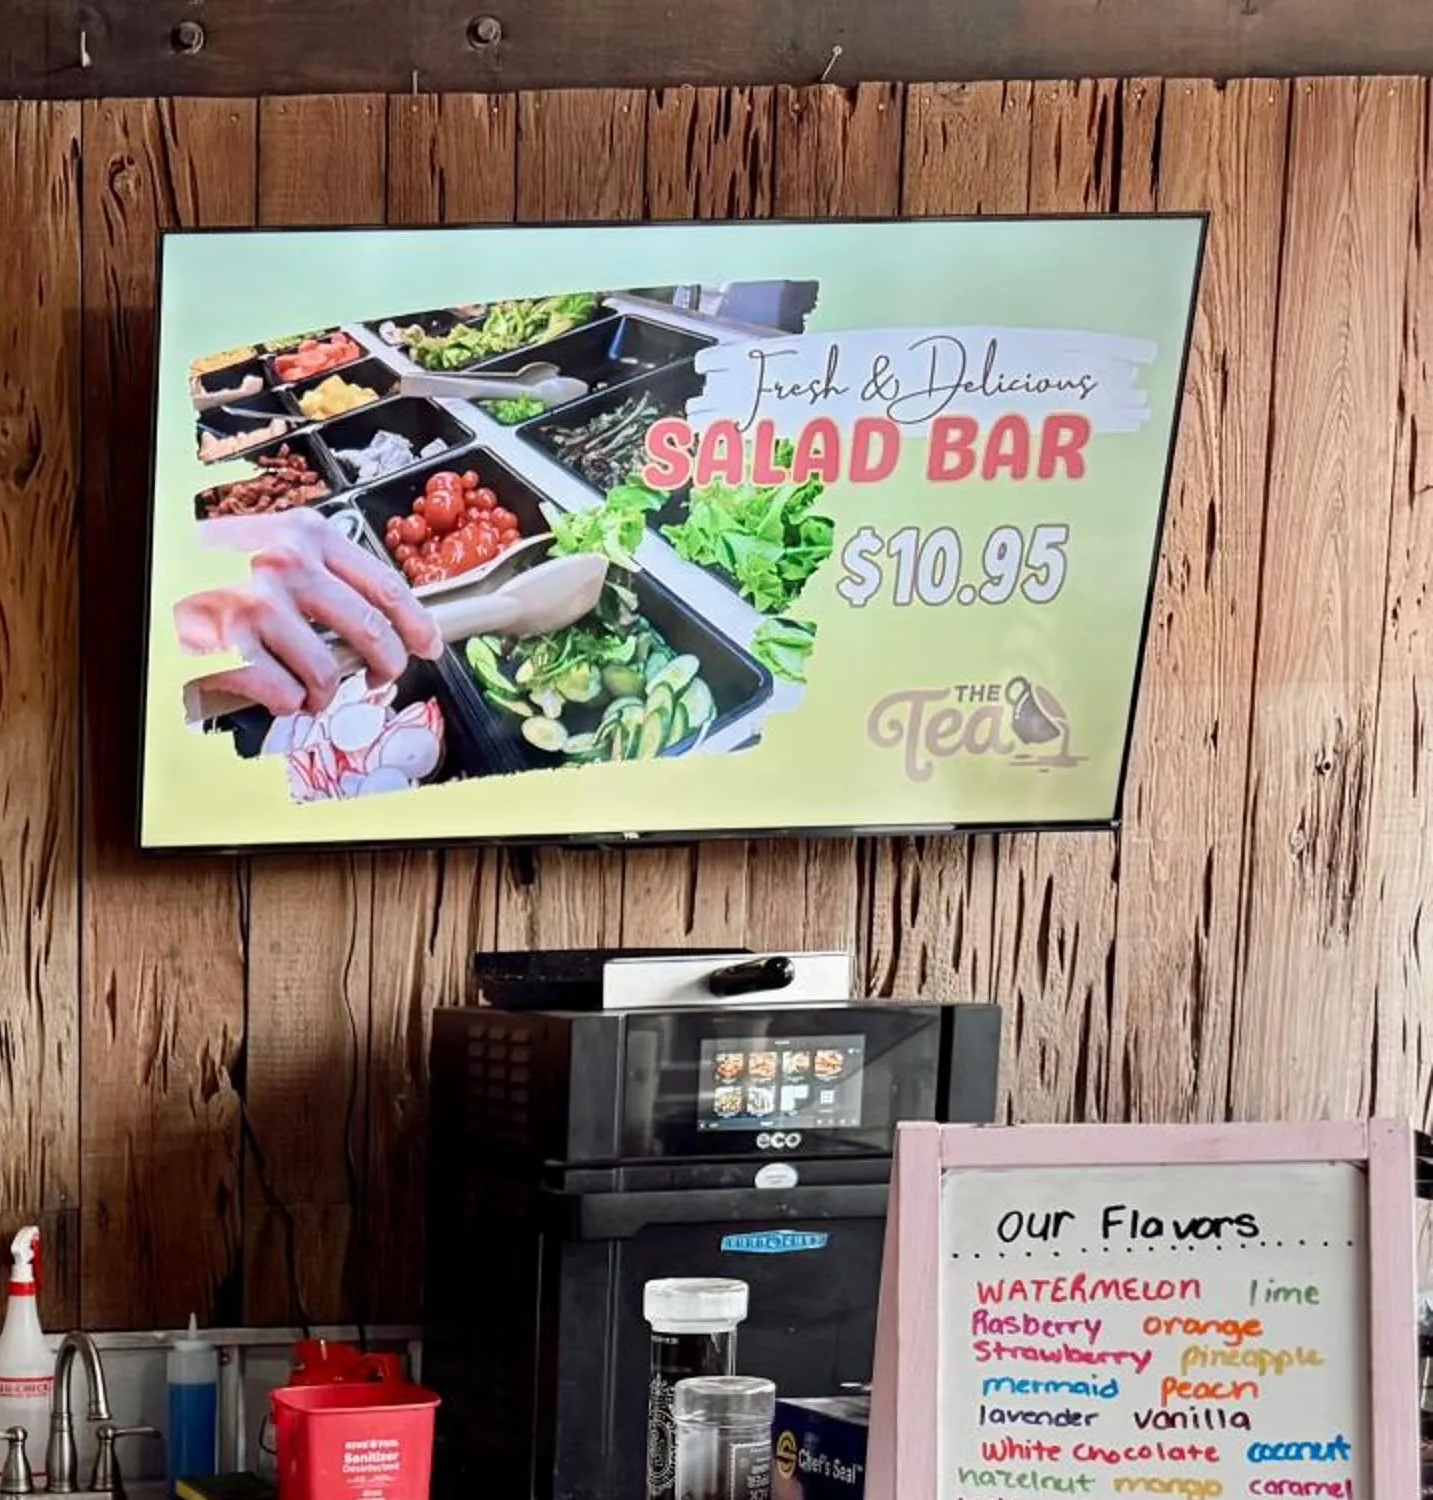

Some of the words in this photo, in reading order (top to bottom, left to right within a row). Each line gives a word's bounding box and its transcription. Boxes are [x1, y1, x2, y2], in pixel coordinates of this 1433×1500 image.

[736, 347, 849, 433] Fresh
[886, 335, 1099, 424] Delicious
[641, 416, 900, 489] SALAD
[927, 414, 1092, 483] BAR
[836, 524, 1070, 607] $10.95
[954, 685, 1000, 702] THE
[867, 686, 1014, 782] Tea
[755, 1132, 802, 1149] eco
[1102, 1205, 1261, 1240] Flavors
[1249, 1279, 1320, 1305] lime
[1143, 1316, 1263, 1345] orange
[1180, 1345, 1326, 1375] pineapple
[982, 1373, 1120, 1398] mermaid
[980, 1404, 1099, 1428] lavender
[343, 1451, 400, 1463] Sanitizer
[798, 1449, 831, 1476] Chef's
[1246, 1435, 1352, 1463] coconut
[958, 1468, 1095, 1494] hazelnut
[1248, 1478, 1353, 1500] caramel
